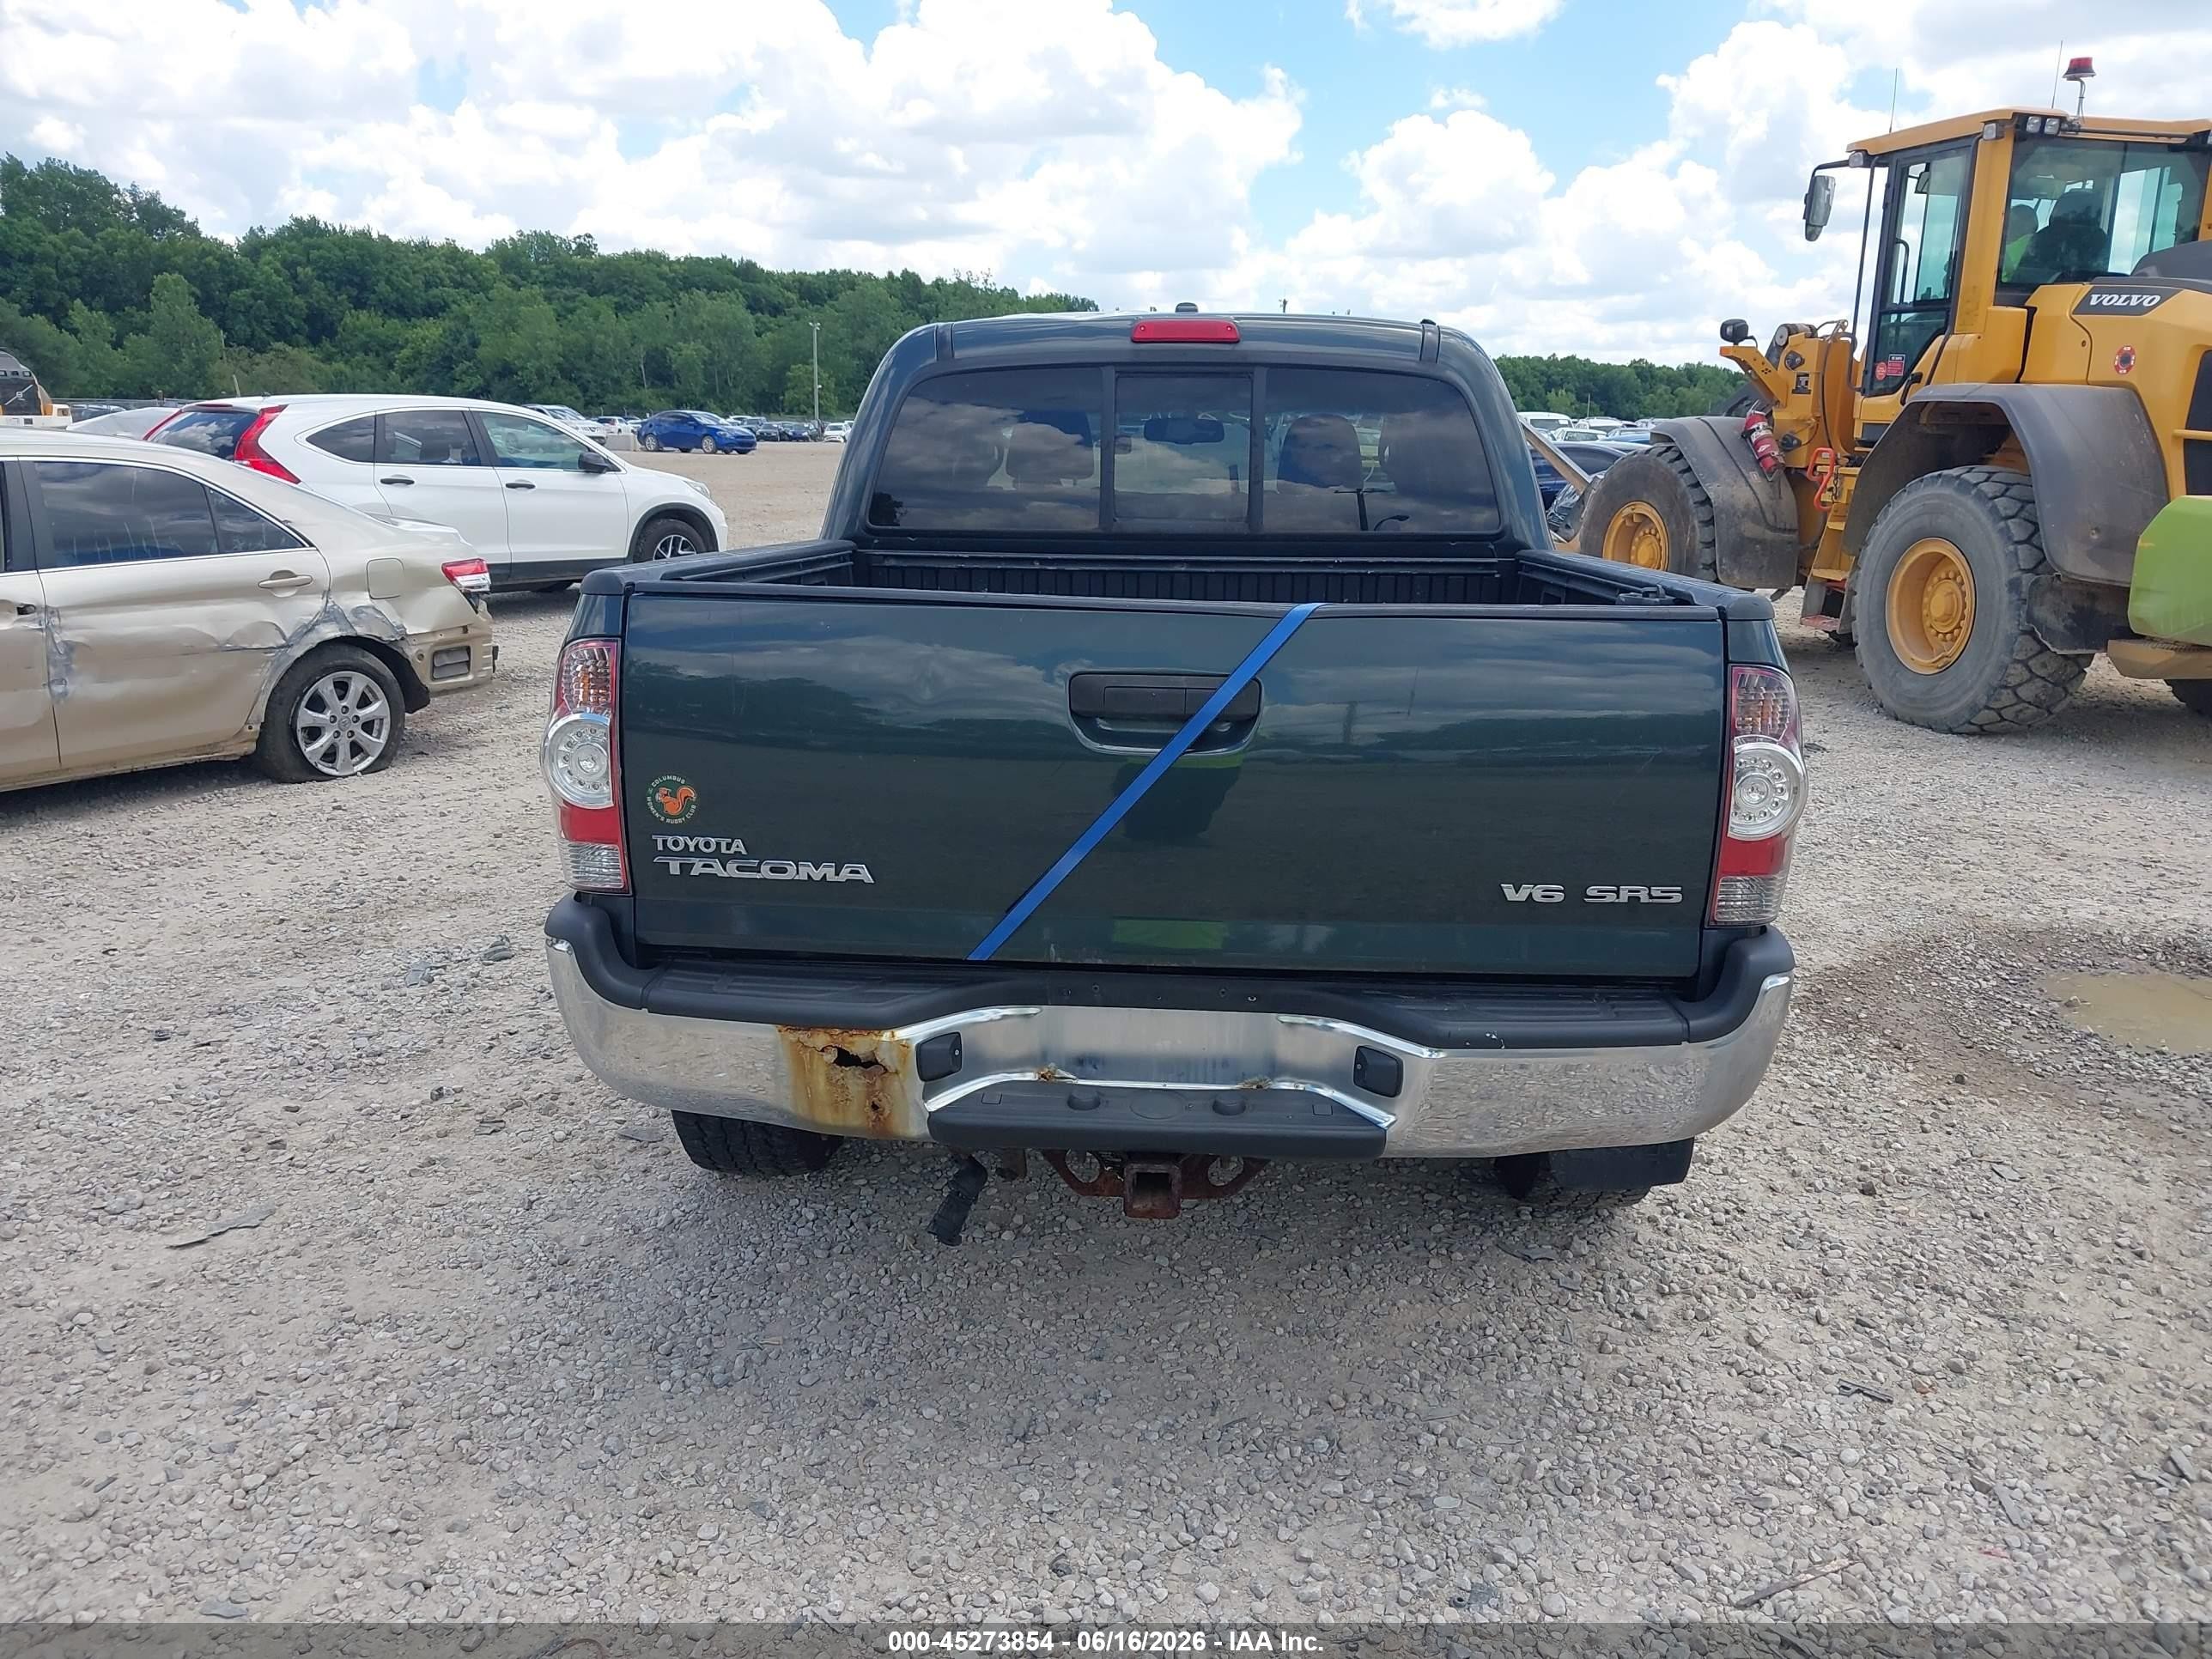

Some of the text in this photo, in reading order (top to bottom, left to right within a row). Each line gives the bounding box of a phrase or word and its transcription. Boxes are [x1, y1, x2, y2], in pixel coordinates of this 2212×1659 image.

[2089, 294, 2161, 307] VOLVO
[651, 775, 686, 787] COLUMBUS
[685, 805, 696, 818] CLUB
[652, 835, 748, 855] TOYOTA
[653, 856, 875, 884] TACOMA
[1500, 884, 1683, 902] V6 SR5
